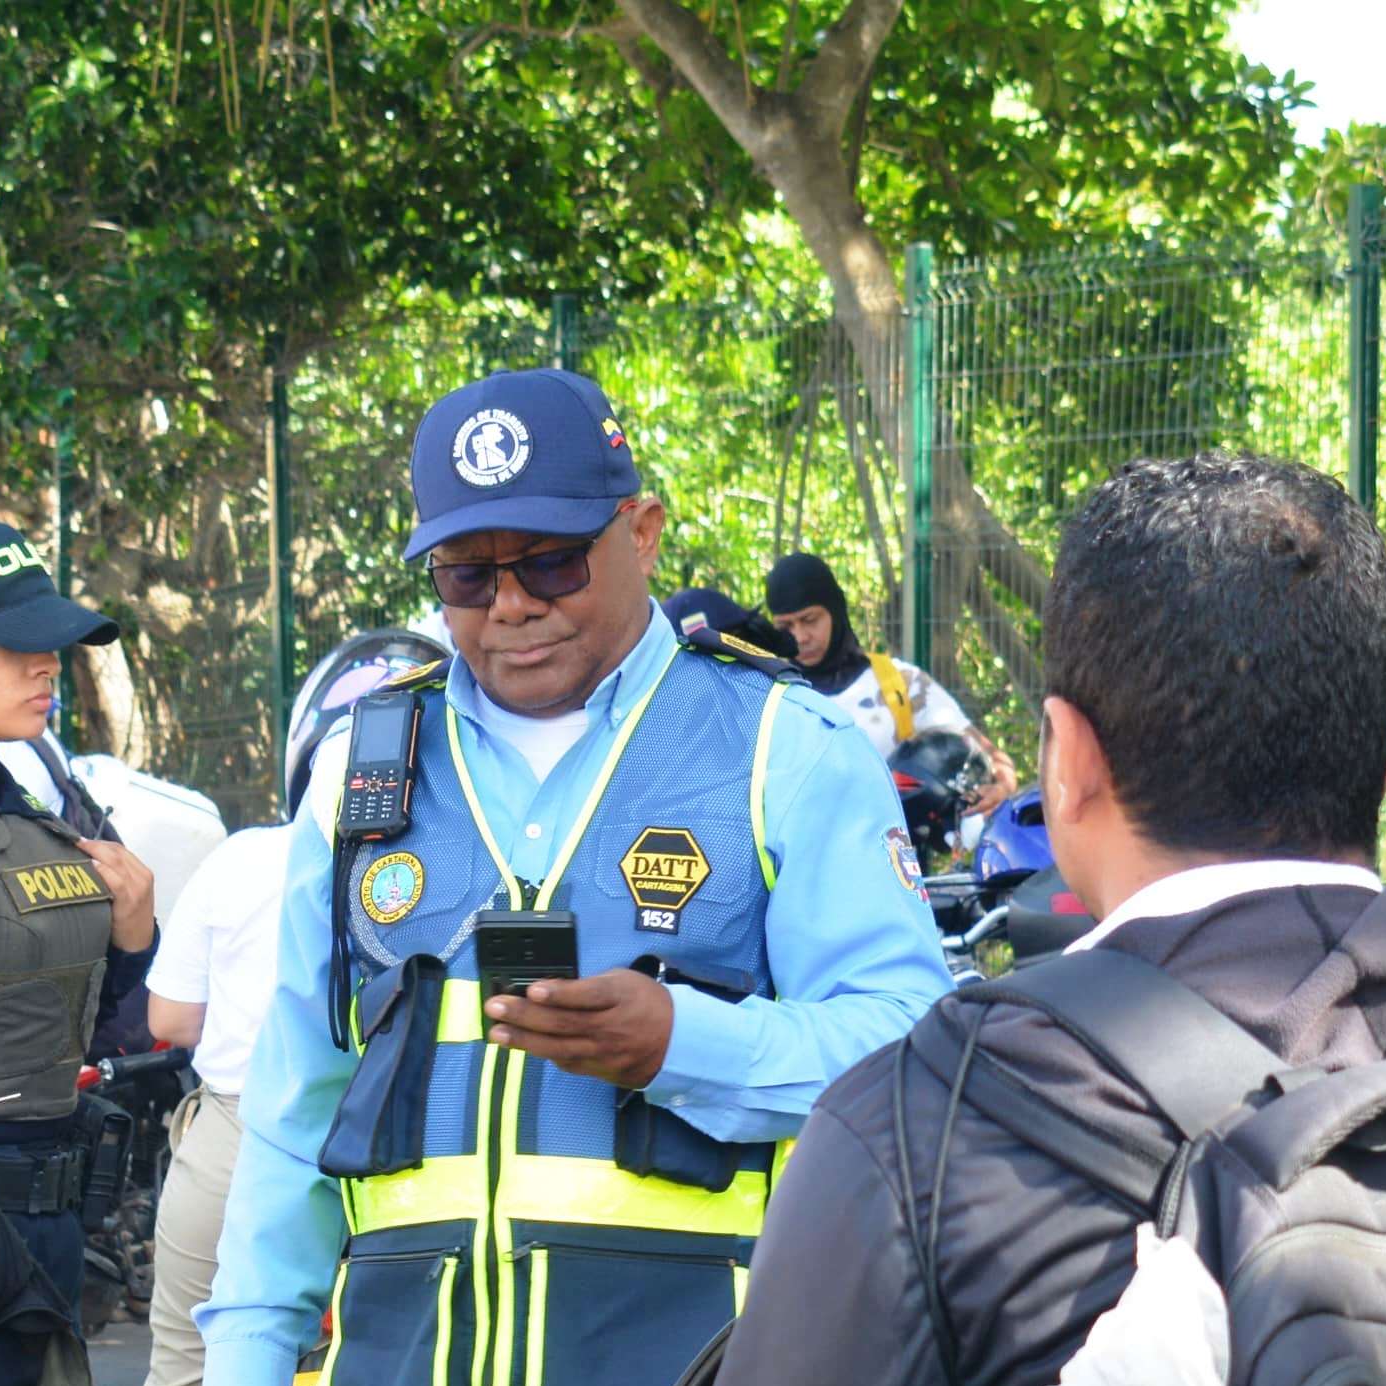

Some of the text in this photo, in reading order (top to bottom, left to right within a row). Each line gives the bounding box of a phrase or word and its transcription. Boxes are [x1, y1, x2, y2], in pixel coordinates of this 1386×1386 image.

[632, 856, 698, 879] DATT
[16, 864, 101, 905] POLICIA
[635, 881, 687, 893] CARTAGENA
[641, 909, 675, 929] 152
